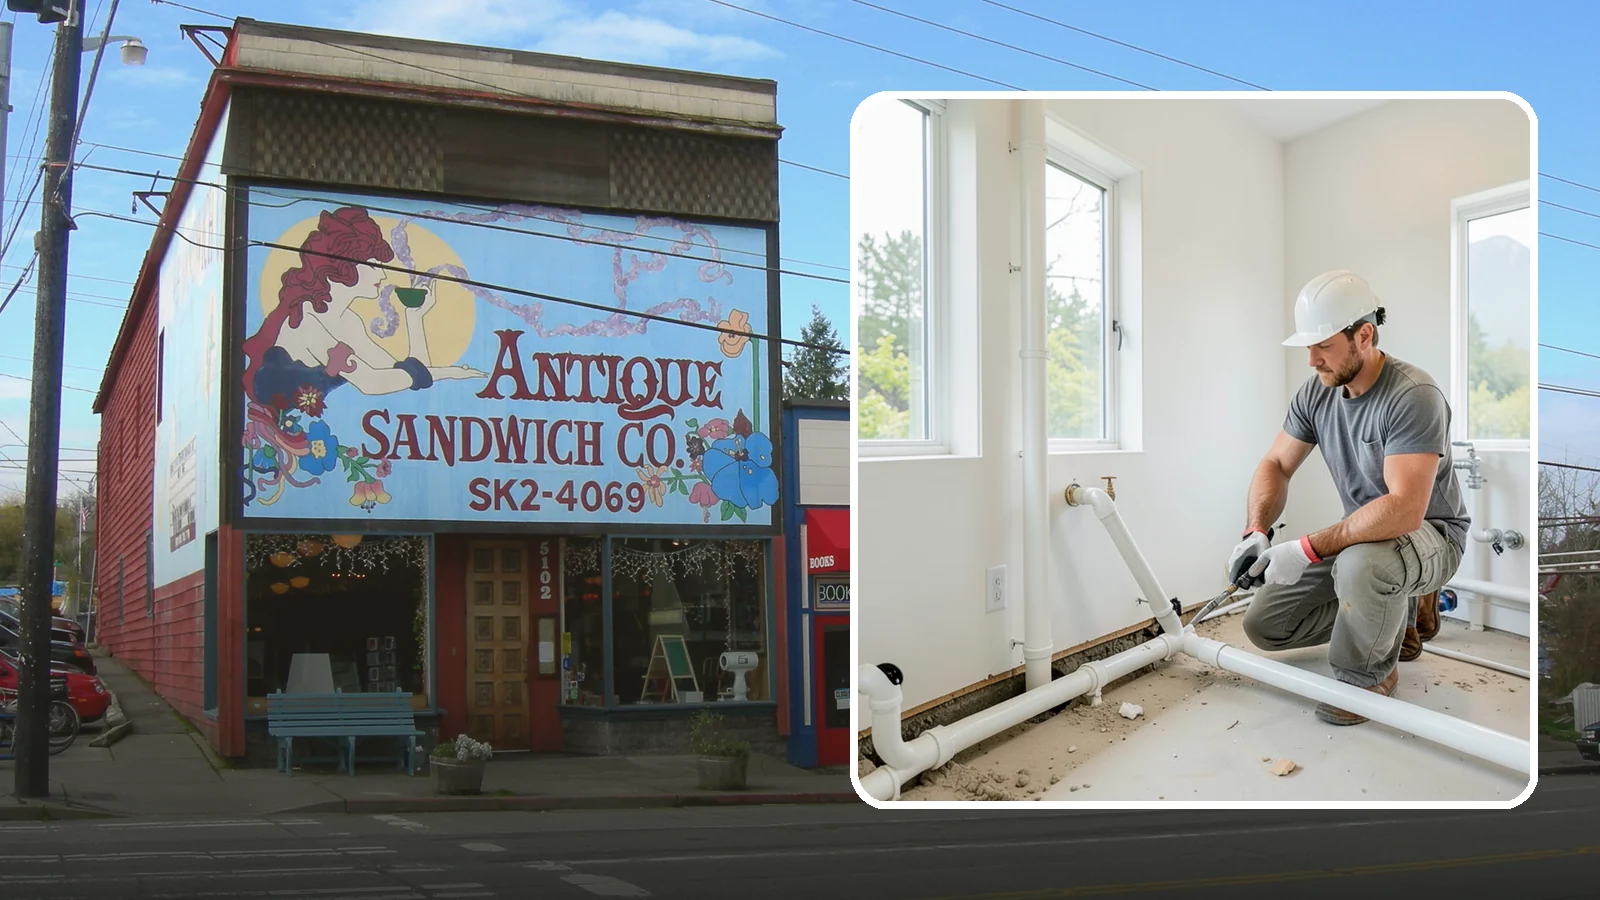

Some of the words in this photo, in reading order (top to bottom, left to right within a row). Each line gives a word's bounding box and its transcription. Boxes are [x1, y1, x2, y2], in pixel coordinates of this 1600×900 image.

[476, 330, 723, 420] ANTIQUE
[361, 409, 605, 467] SANDWICH
[617, 422, 685, 469] CO.
[468, 478, 646, 512] SK2-4069
[540, 541, 551, 600] 5102
[809, 555, 834, 569] BOOKS
